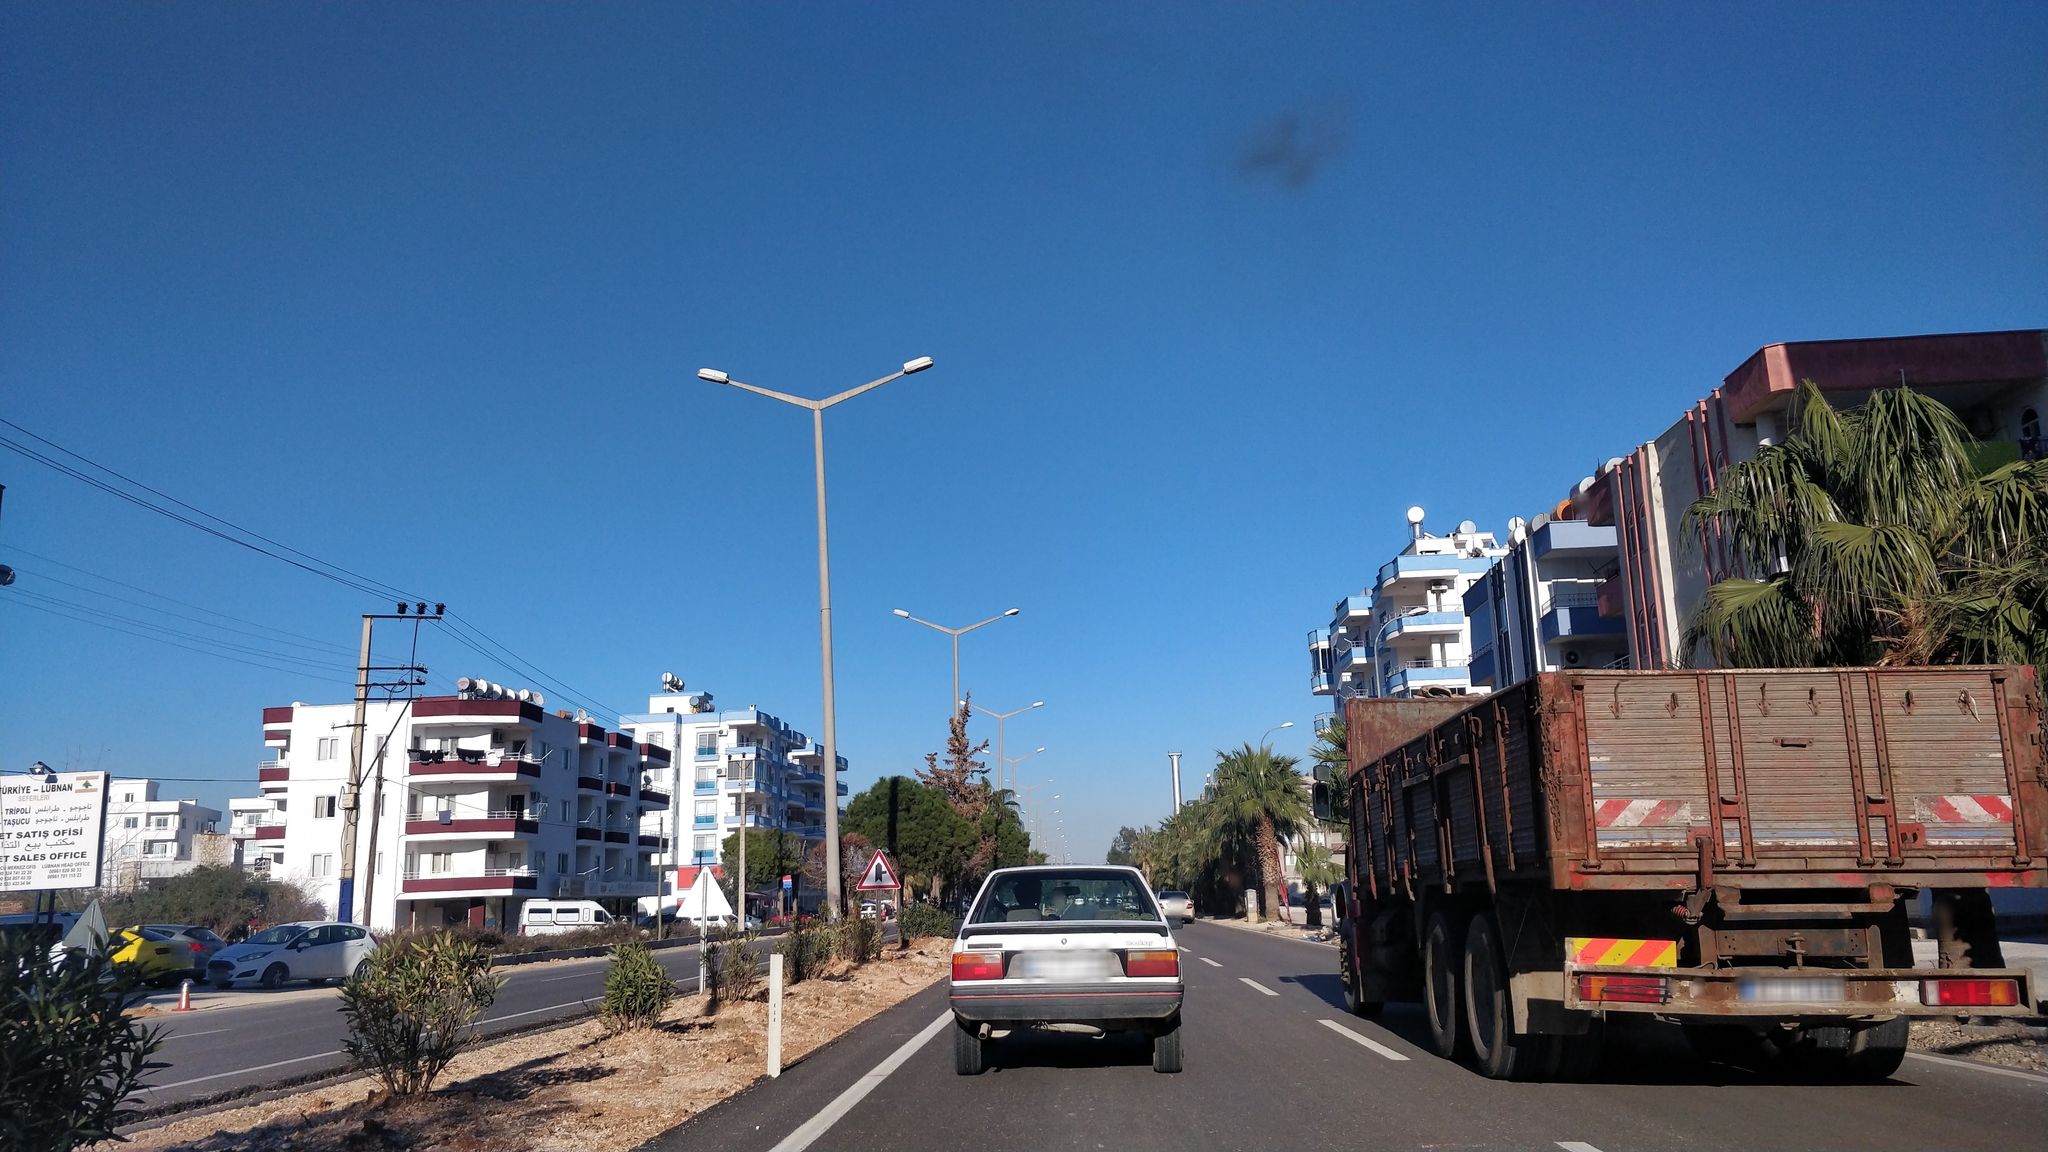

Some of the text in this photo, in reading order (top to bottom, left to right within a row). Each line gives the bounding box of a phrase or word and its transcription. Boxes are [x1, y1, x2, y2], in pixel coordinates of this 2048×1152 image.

[5, 806, 31, 815] TRİPOLİ
[4, 818, 30, 827] TAŞUCU
[16, 830, 49, 840] SATIŞ
[53, 826, 83, 837] OFİSİ
[24, 842, 41, 852] بيع
[13, 853, 46, 862] SALES
[50, 851, 88, 860] OFFICE
